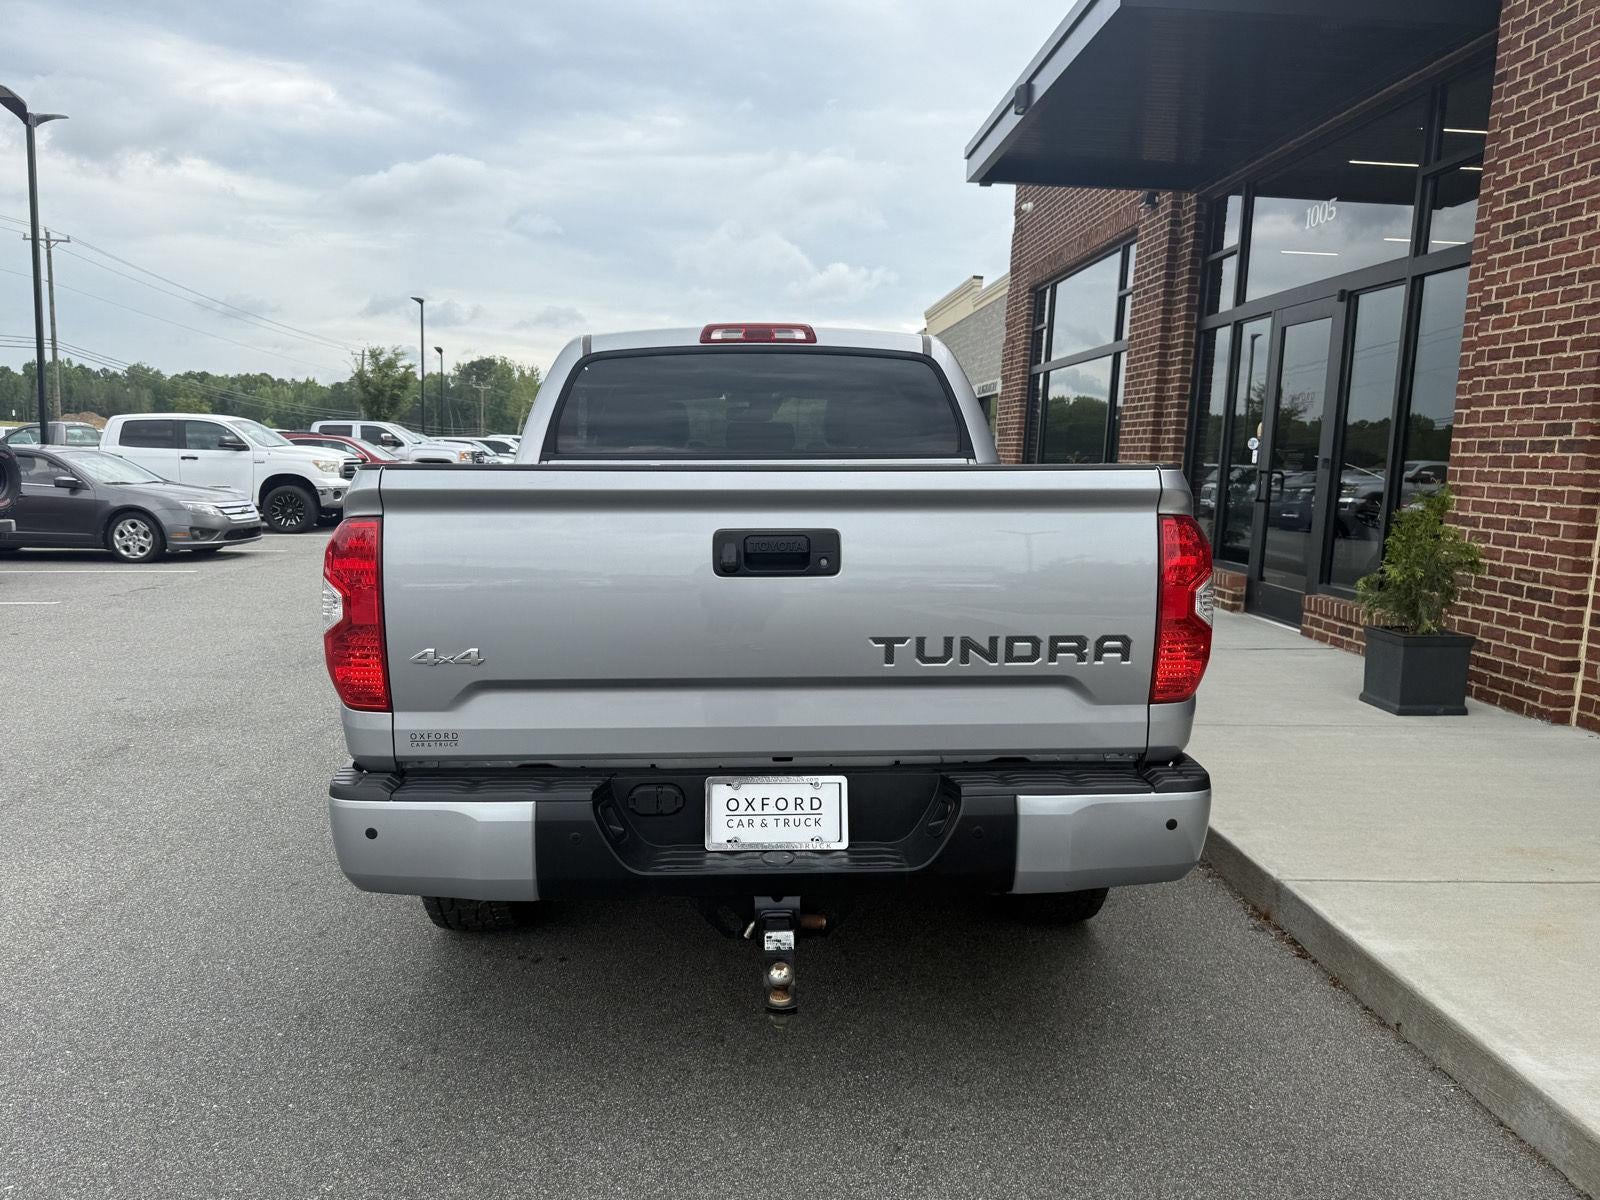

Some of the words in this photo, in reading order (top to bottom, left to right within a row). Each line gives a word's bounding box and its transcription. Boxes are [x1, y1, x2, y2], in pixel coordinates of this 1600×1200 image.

[1305, 197, 1337, 230] 1005
[751, 542, 807, 551] TOYOTA
[409, 647, 486, 667] 4x4
[868, 634, 1133, 667] TUNDRA
[410, 732, 459, 740] OXFORD
[726, 796, 823, 812] OXFORD
[726, 818, 755, 829] CAR
[760, 818, 768, 828] &
[774, 817, 822, 828] TRUCK
